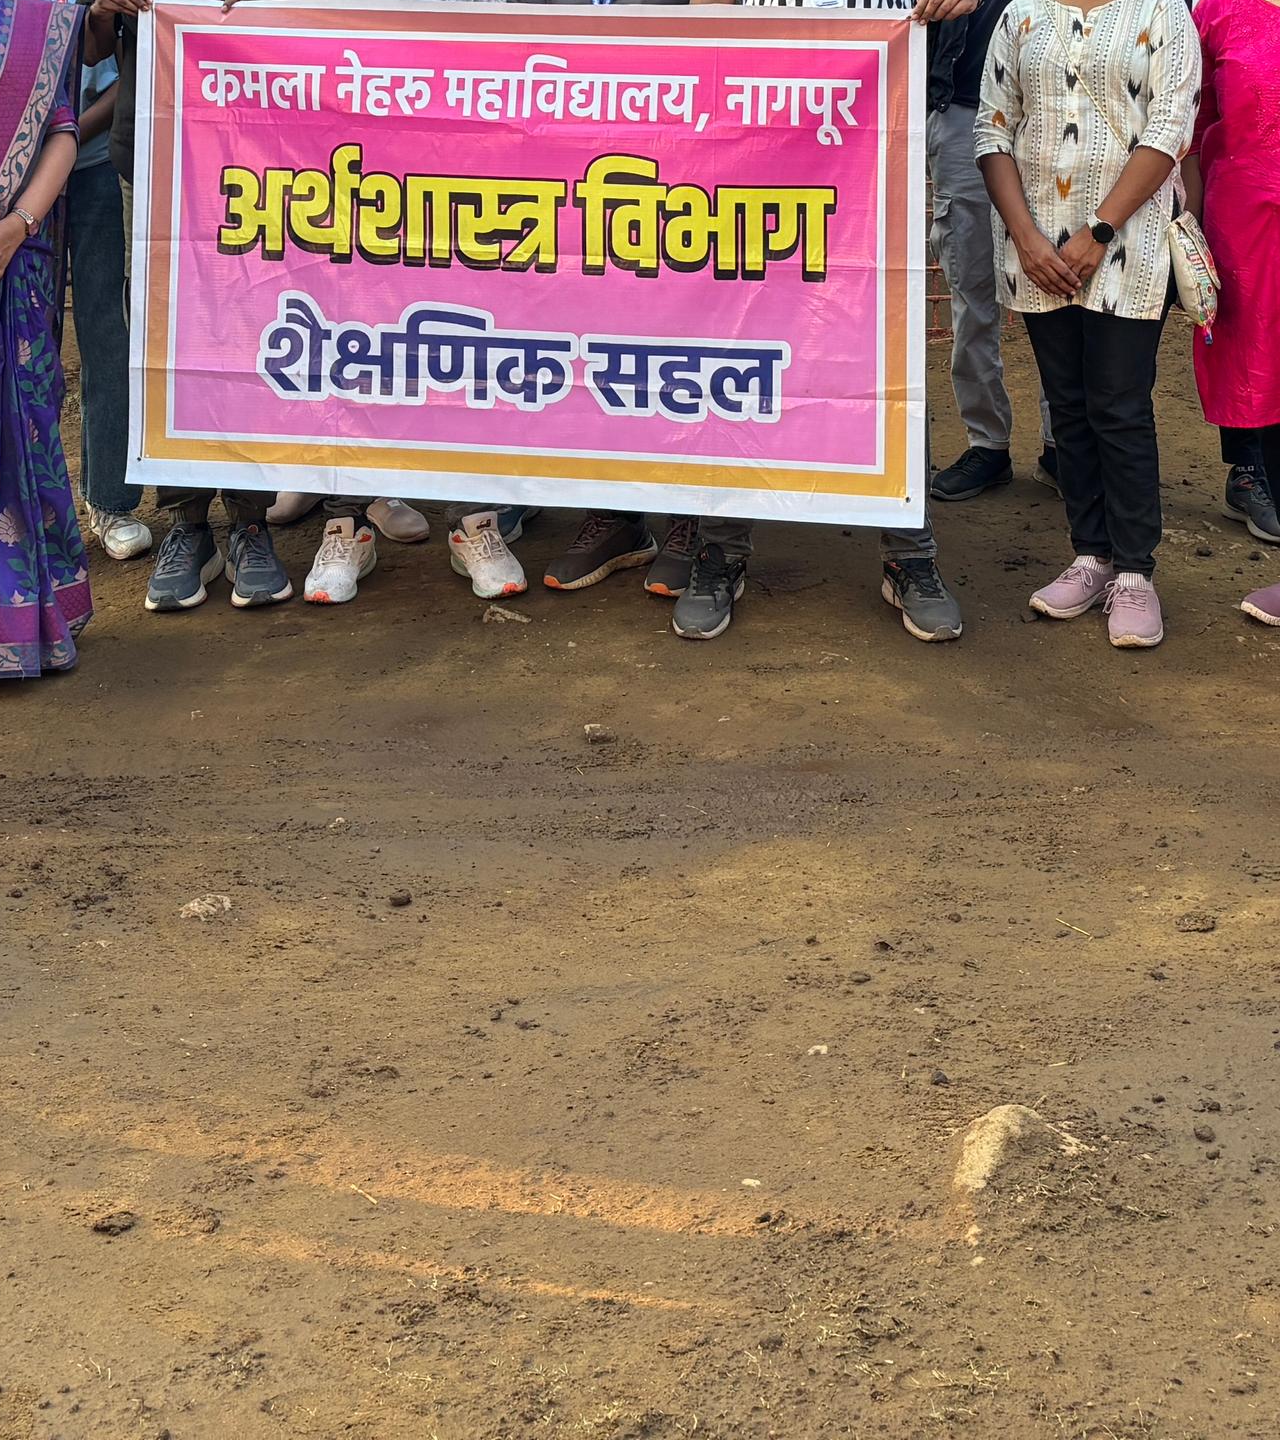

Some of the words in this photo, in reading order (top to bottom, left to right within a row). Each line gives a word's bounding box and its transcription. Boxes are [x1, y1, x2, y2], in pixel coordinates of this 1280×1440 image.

[198, 59, 327, 111] कमला
[335, 48, 435, 117] नेहरू
[443, 53, 711, 133] महाविद्यालय,
[724, 76, 862, 146] नागपूर
[217, 143, 567, 274] अर्थशास्त्र
[572, 152, 837, 282] विभाग
[262, 296, 573, 406] शैक्षणिक
[585, 340, 786, 417] सहल
